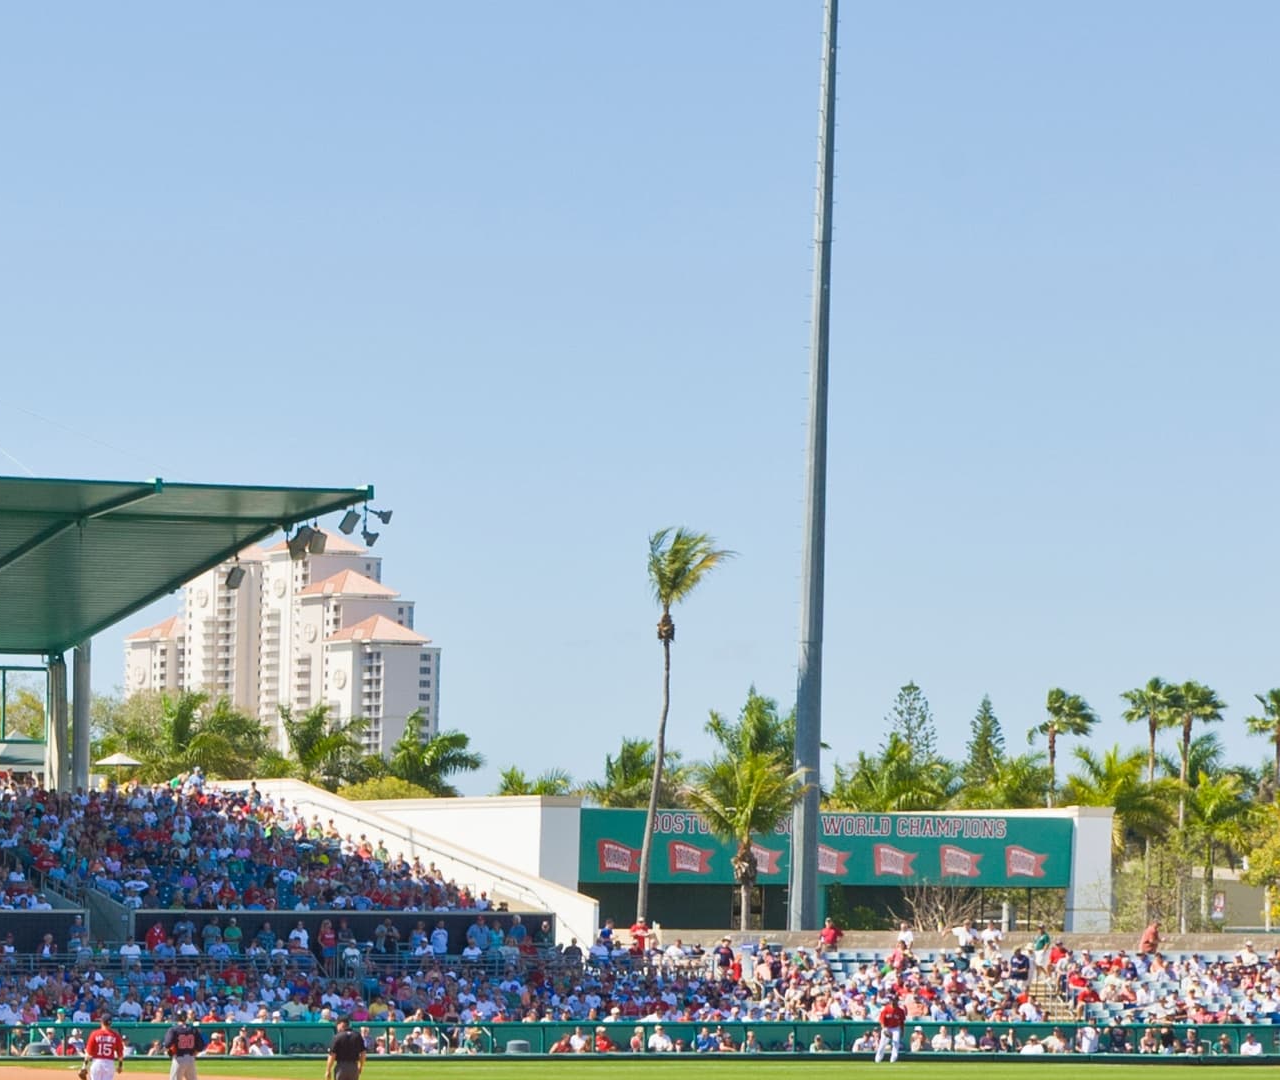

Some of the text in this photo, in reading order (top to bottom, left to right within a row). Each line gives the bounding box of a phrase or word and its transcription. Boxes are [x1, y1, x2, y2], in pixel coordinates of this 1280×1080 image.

[652, 812, 714, 835] BOSTO
[822, 816, 892, 837] WORLD
[897, 816, 1007, 839] CHAMPIONS
[97, 1043, 113, 1056] 15
